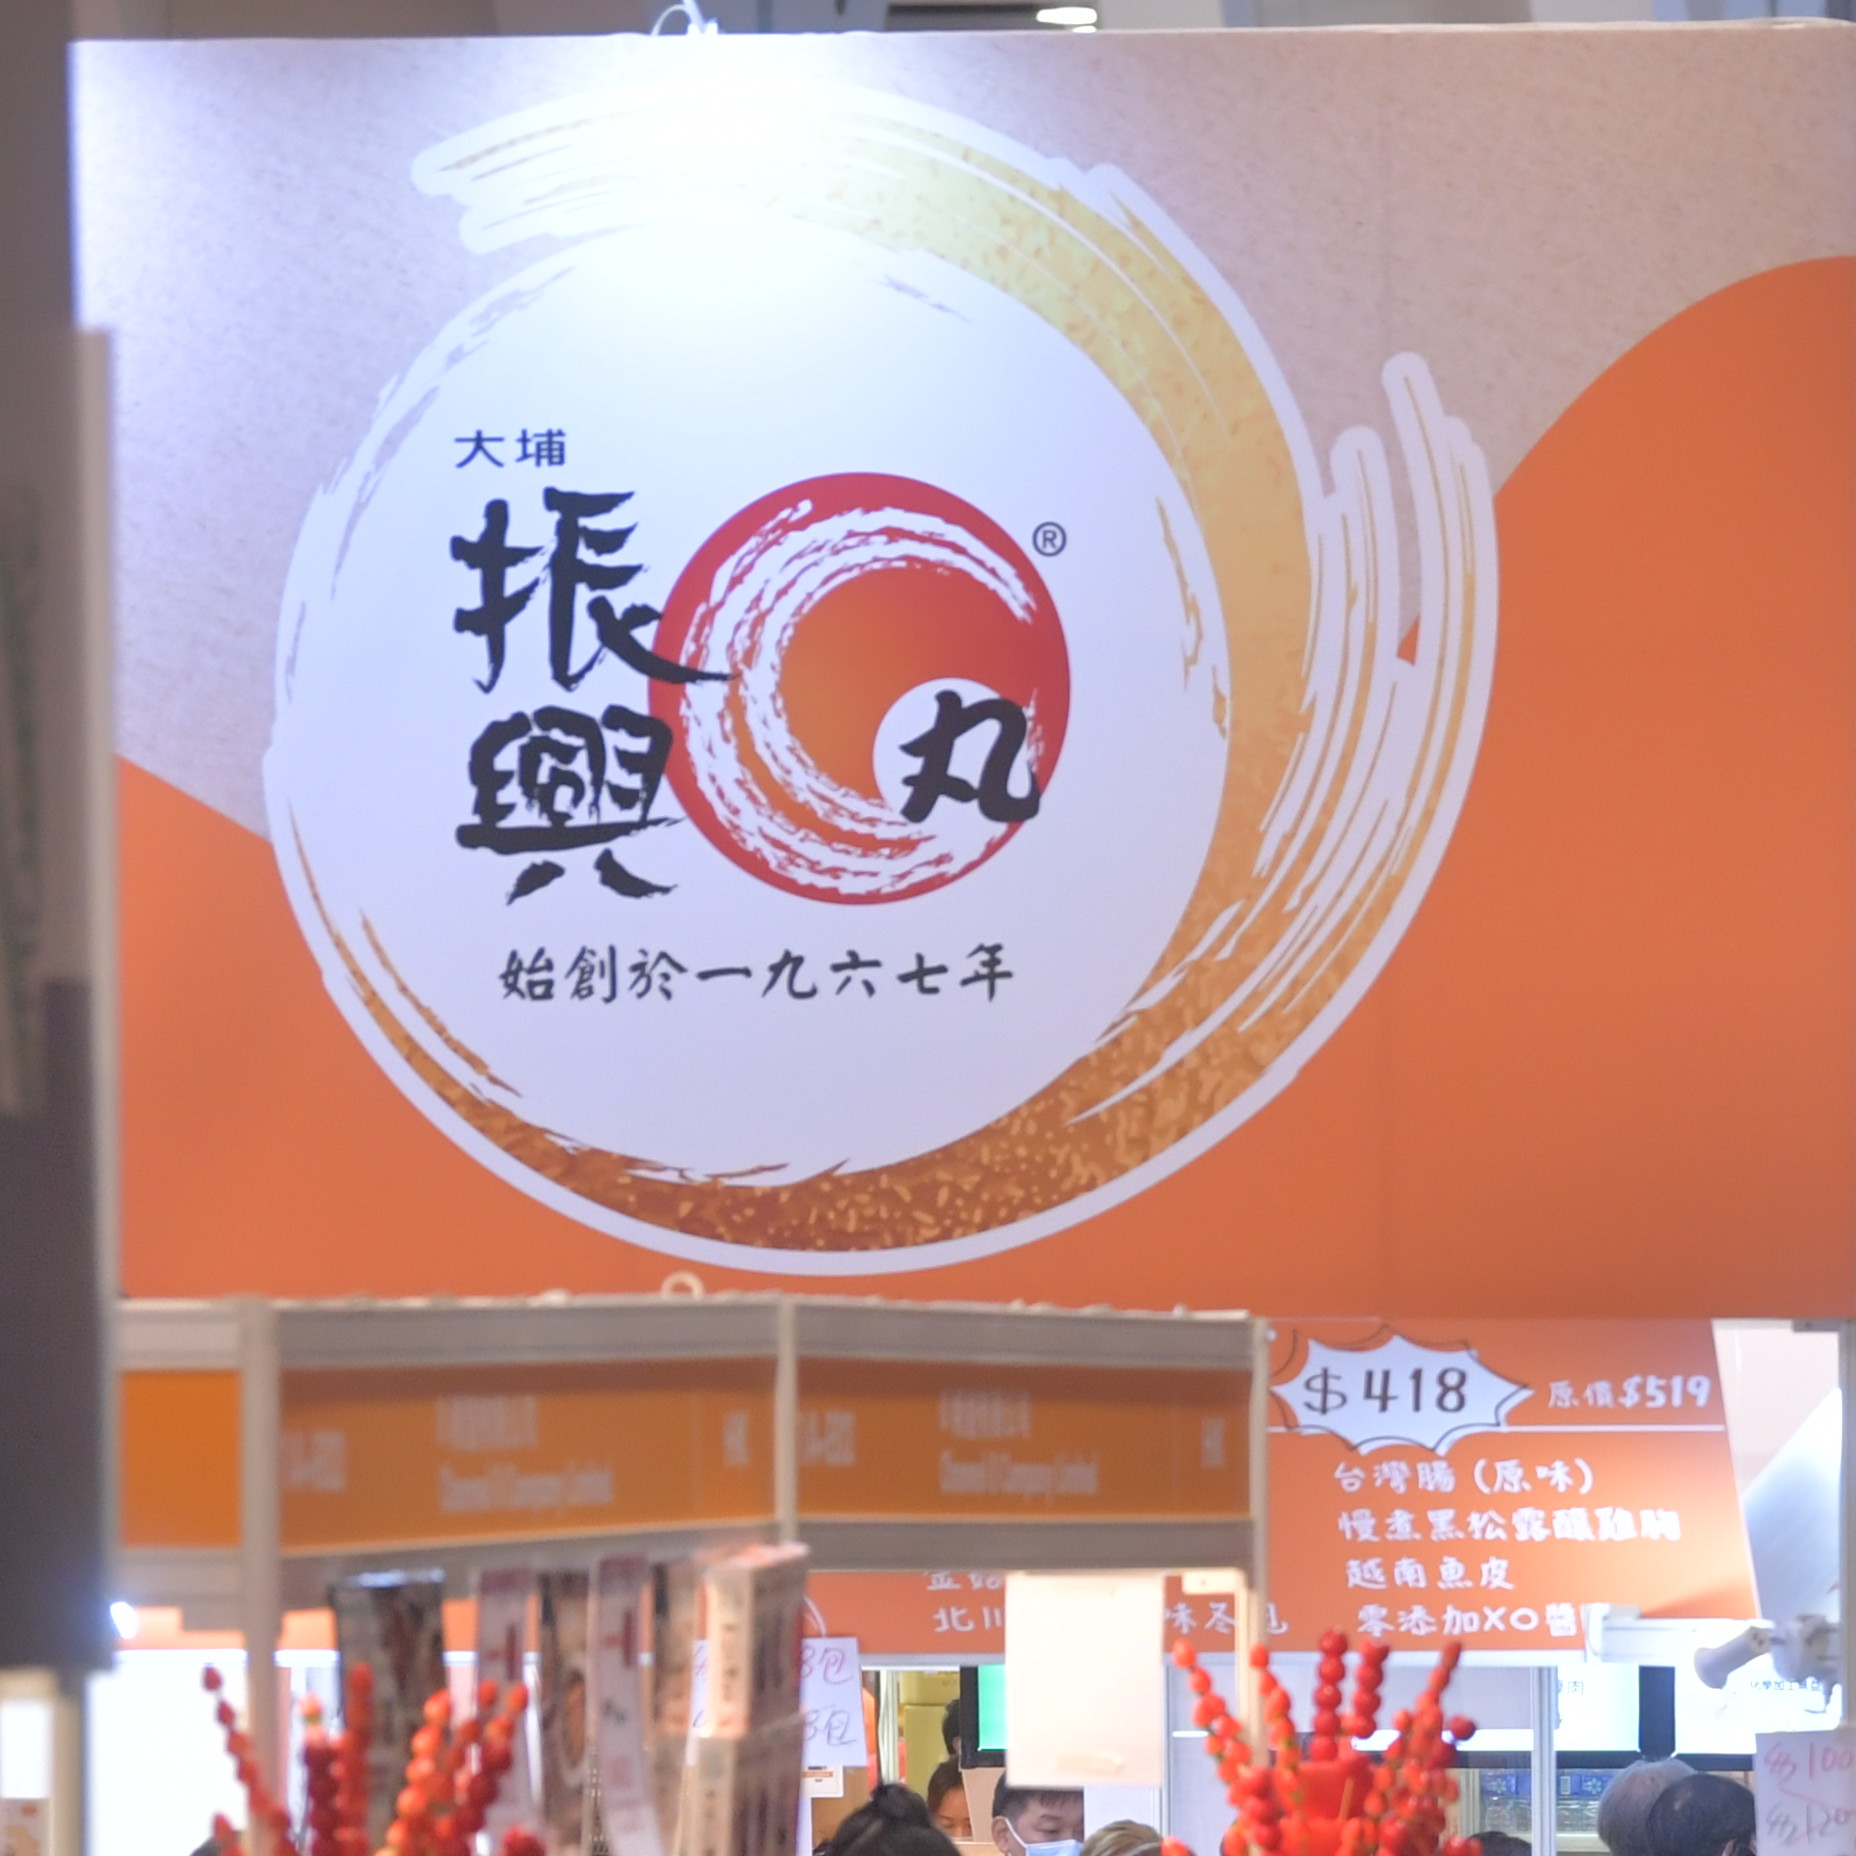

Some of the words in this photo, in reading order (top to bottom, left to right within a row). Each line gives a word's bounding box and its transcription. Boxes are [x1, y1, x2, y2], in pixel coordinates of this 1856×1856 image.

[453, 428, 568, 470] 大埔
[500, 943, 1015, 1002] 始創於一九六七年
[1302, 1367, 1468, 1416] $418
[1345, 1556, 1516, 1591] 越南魚皮
